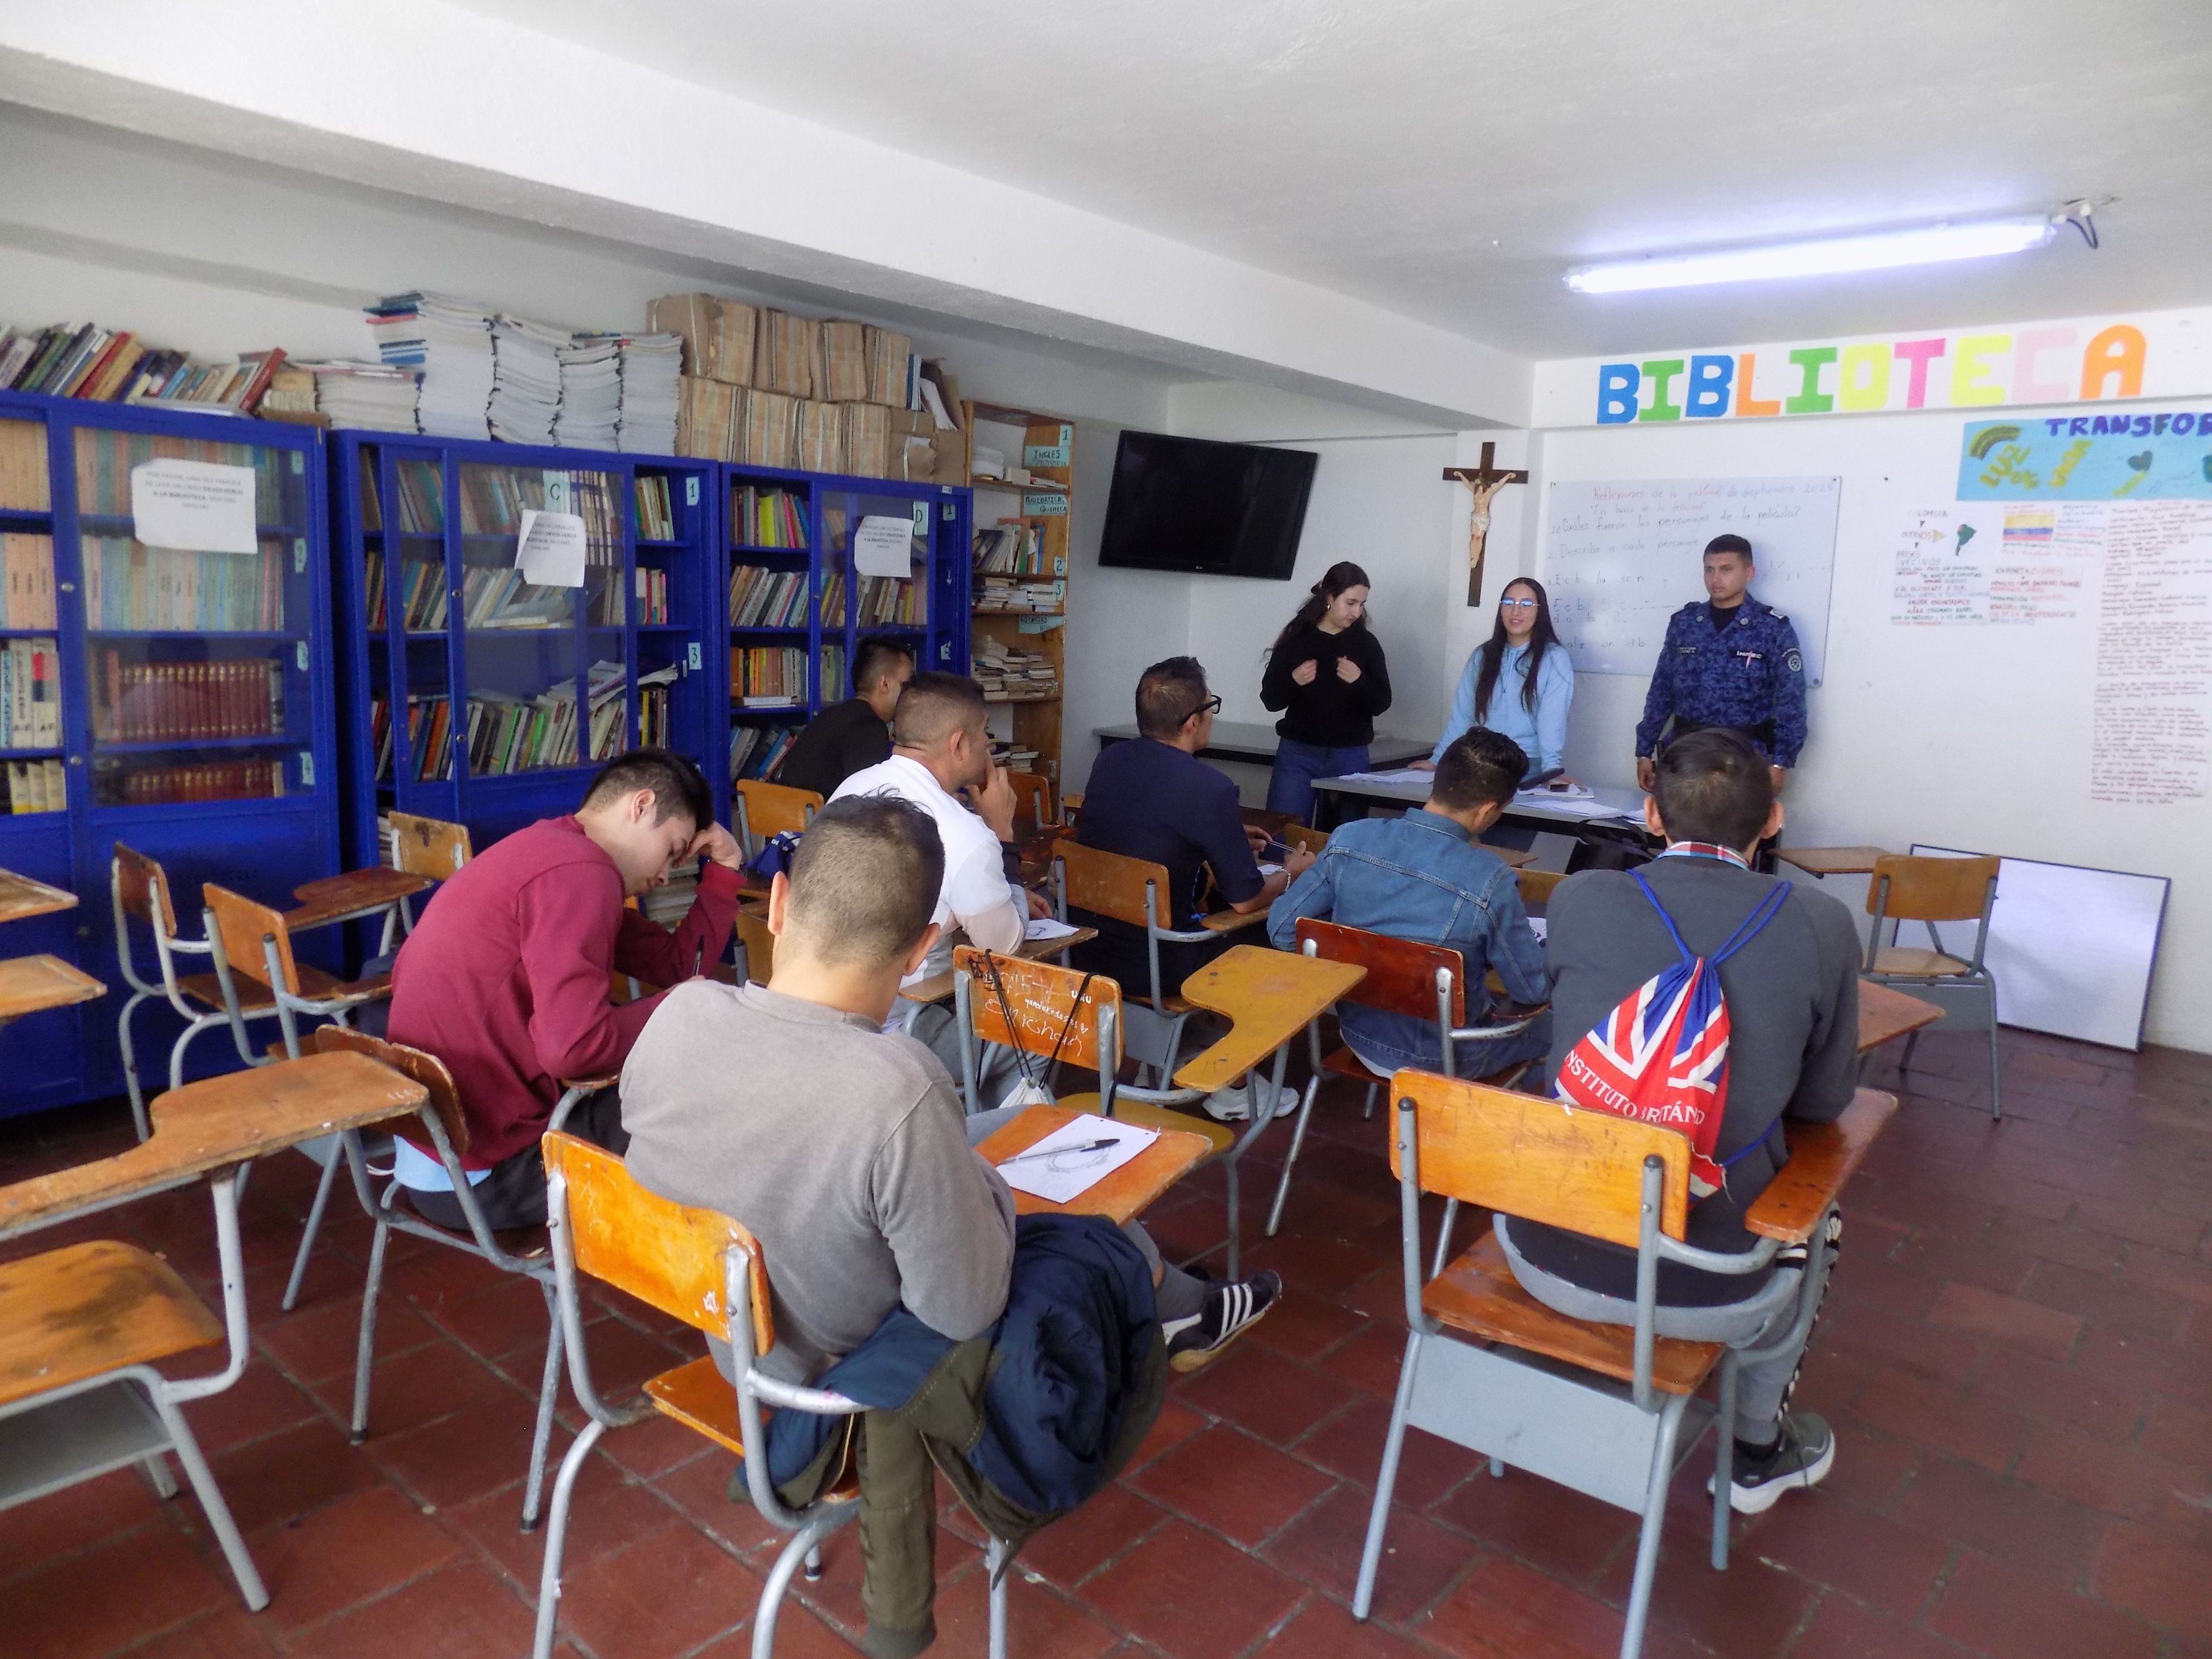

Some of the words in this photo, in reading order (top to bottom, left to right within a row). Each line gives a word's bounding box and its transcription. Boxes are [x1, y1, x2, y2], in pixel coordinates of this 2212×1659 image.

[1596, 324, 2147, 425] BIBLIOTECA
[1062, 430, 1067, 440] 1
[1033, 449, 1060, 459] INGLES
[550, 483, 561, 500] C
[690, 483, 696, 497] 1
[915, 509, 923, 523] D
[1596, 516, 1627, 531] fueron
[1720, 509, 1732, 521] de
[1056, 560, 1062, 571] 2
[1056, 584, 1061, 596] 3
[691, 647, 698, 664] 3
[1565, 1050, 1637, 1118] NSTITUTO
